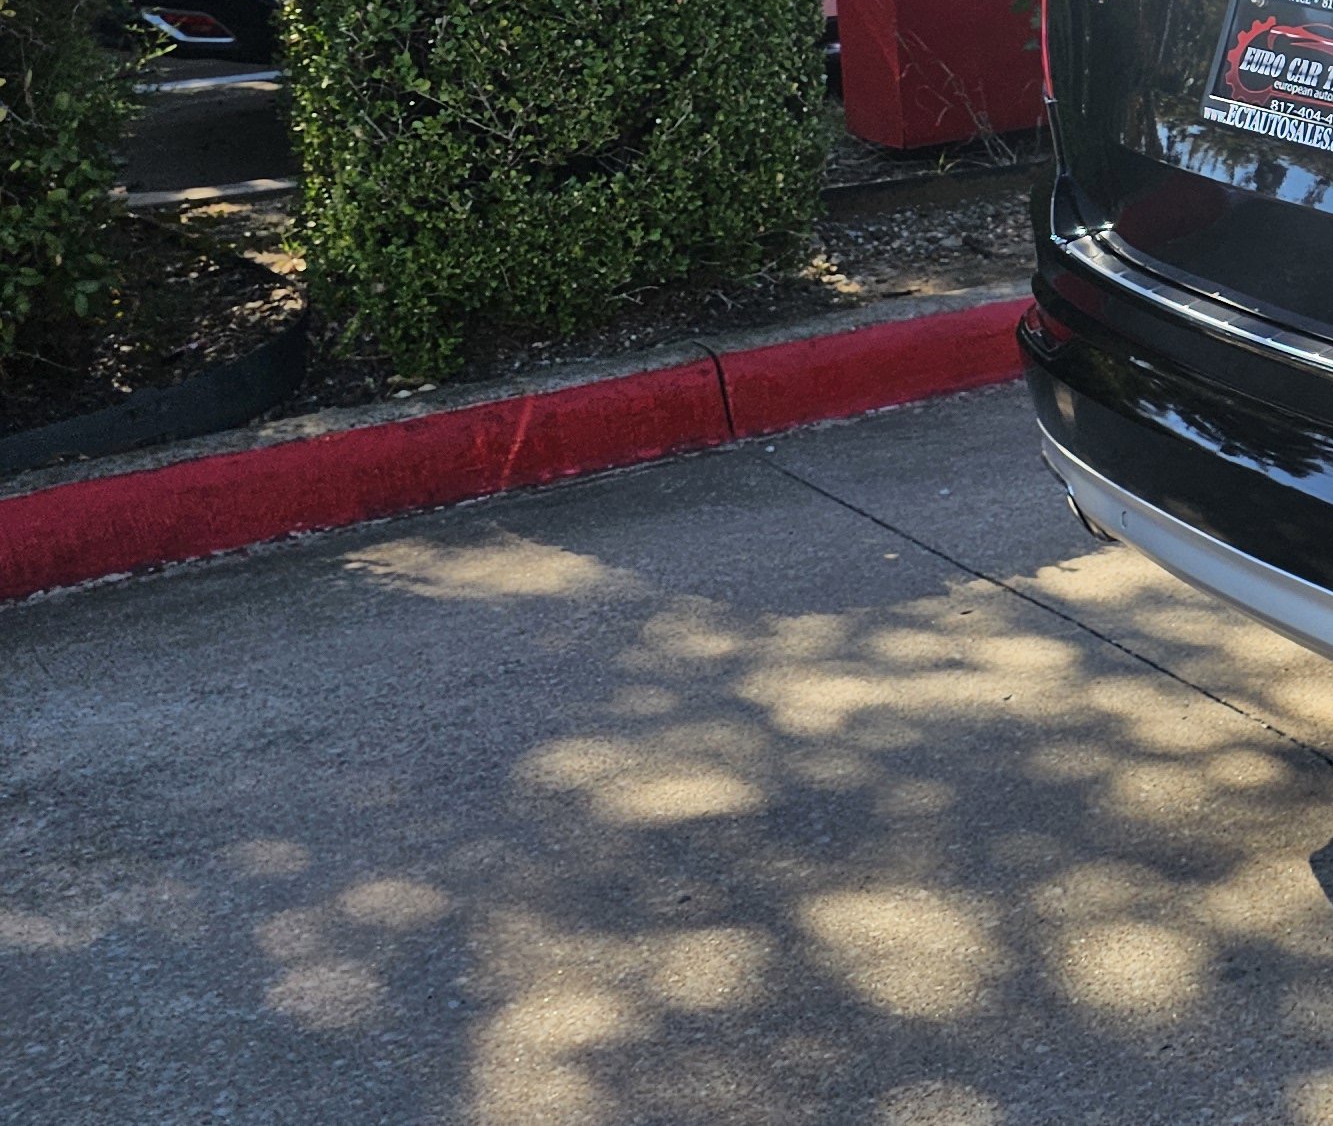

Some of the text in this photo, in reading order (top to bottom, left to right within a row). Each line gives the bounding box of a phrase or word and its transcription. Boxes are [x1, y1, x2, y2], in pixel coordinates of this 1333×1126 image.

[1239, 46, 1286, 78] EURO
[1286, 57, 1323, 87] CAR
[1273, 80, 1313, 97] european
